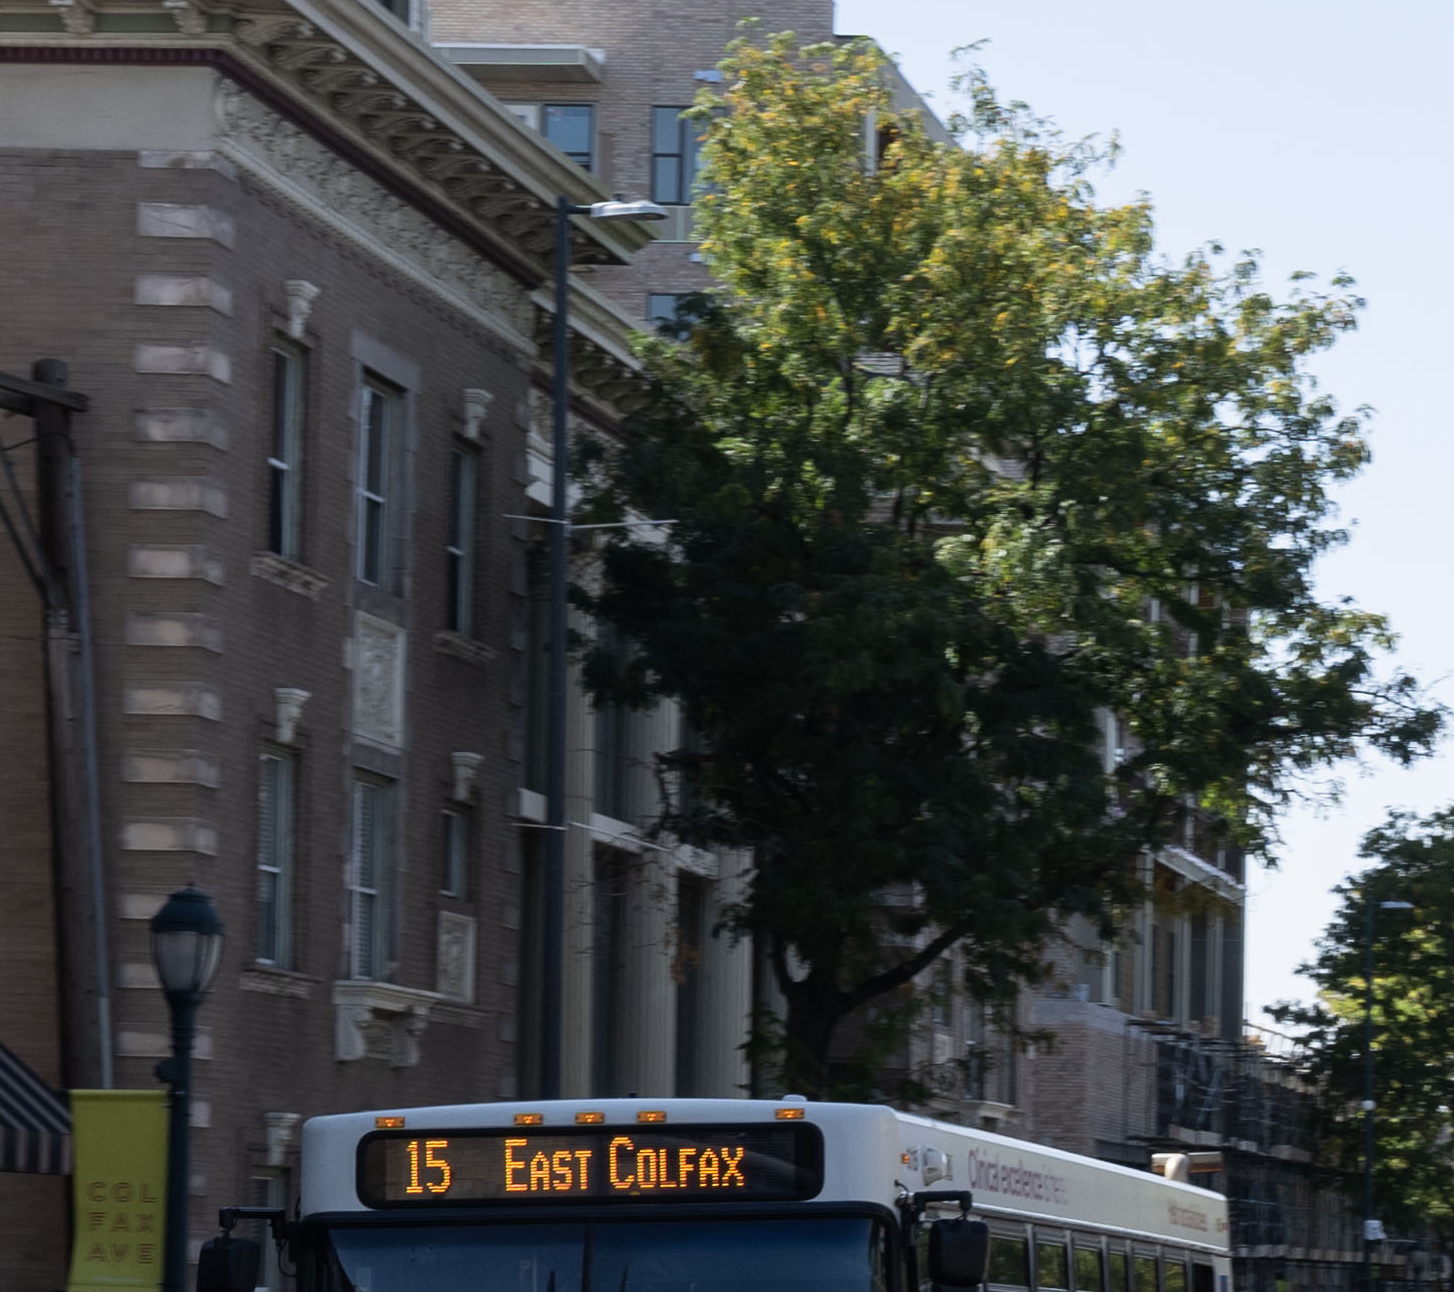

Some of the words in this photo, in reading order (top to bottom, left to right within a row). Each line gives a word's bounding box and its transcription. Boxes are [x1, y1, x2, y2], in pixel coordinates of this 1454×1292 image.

[406, 1140, 451, 1193] 15
[87, 1181, 158, 1203] COL
[89, 1211, 154, 1234] FAX
[87, 1243, 155, 1265] AVE
